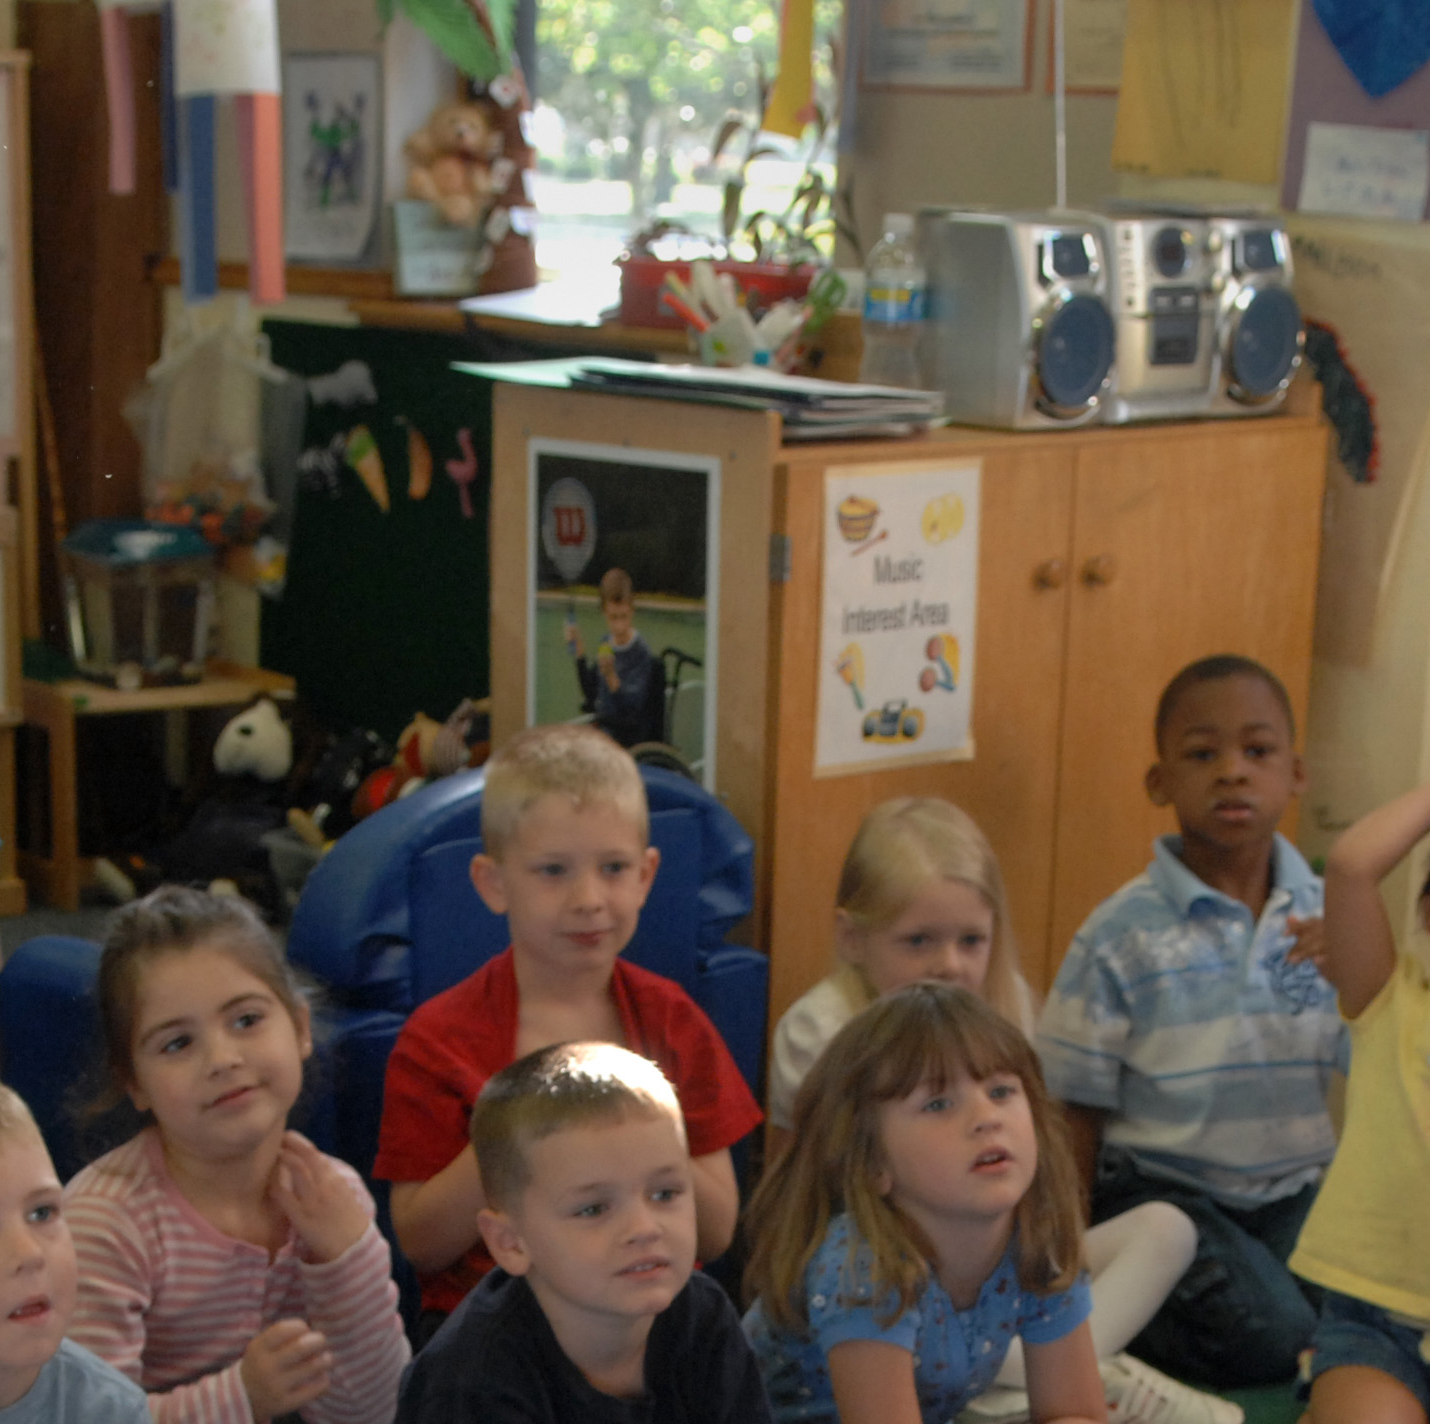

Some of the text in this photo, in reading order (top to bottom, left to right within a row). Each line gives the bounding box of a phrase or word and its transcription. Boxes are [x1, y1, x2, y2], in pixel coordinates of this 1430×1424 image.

[873, 553, 924, 585] Music
[841, 598, 951, 635] Interest Area
